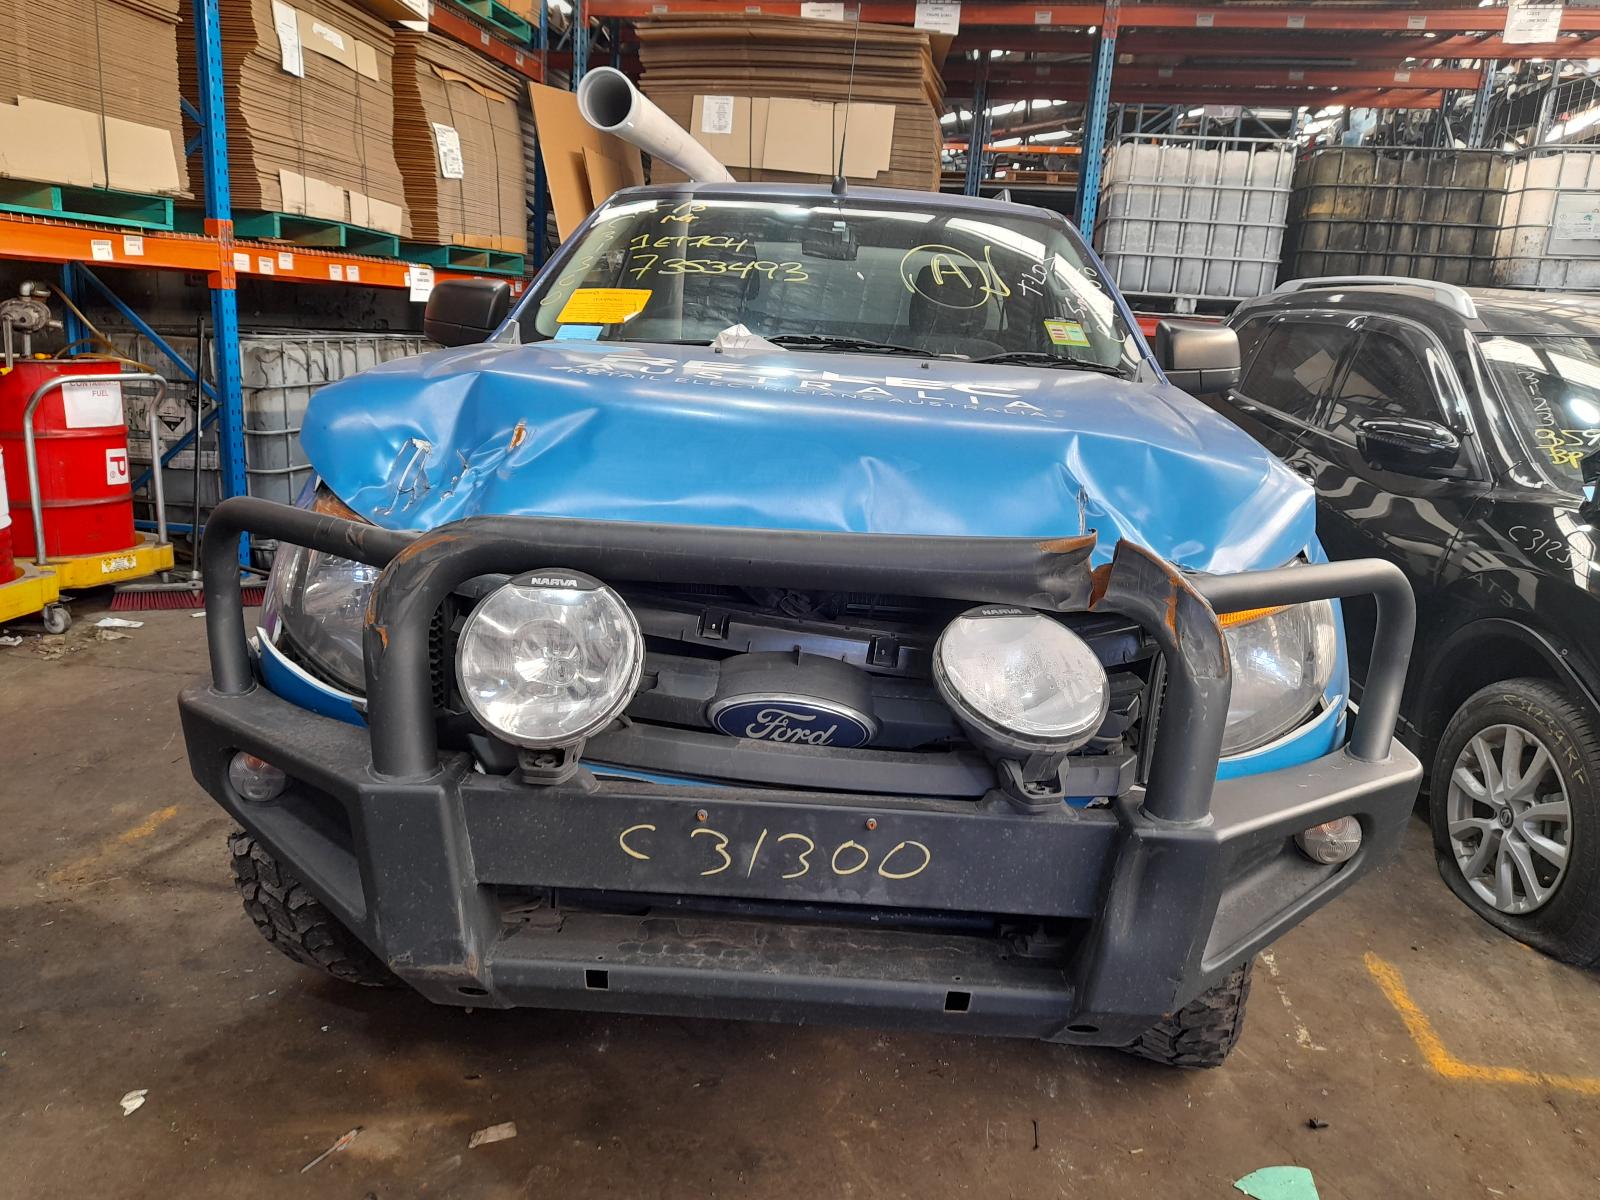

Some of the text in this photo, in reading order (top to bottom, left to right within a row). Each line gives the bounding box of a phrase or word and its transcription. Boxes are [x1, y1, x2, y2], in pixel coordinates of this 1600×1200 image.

[531, 577, 578, 587] NARVA
[981, 608, 1023, 616] NARVA
[745, 708, 838, 746] Ford
